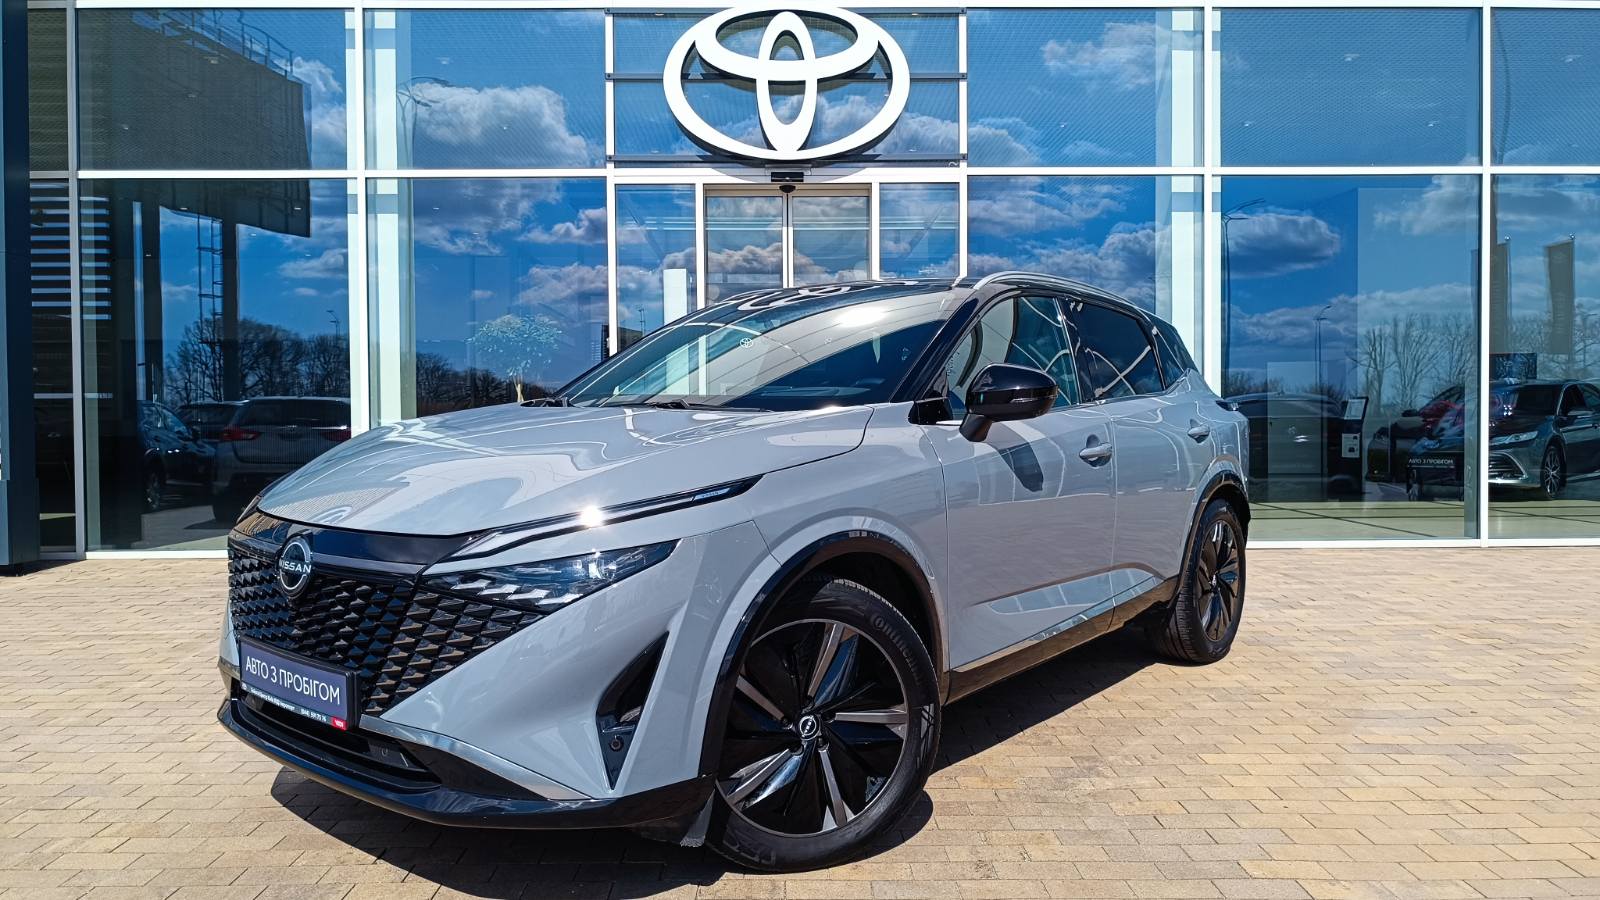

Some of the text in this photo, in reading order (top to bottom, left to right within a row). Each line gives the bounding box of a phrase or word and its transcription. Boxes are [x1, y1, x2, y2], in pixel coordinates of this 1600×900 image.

[279, 560, 312, 574] NISSAN
[246, 656, 269, 679] АВТО
[279, 669, 341, 705] ПРОБІГОМ
